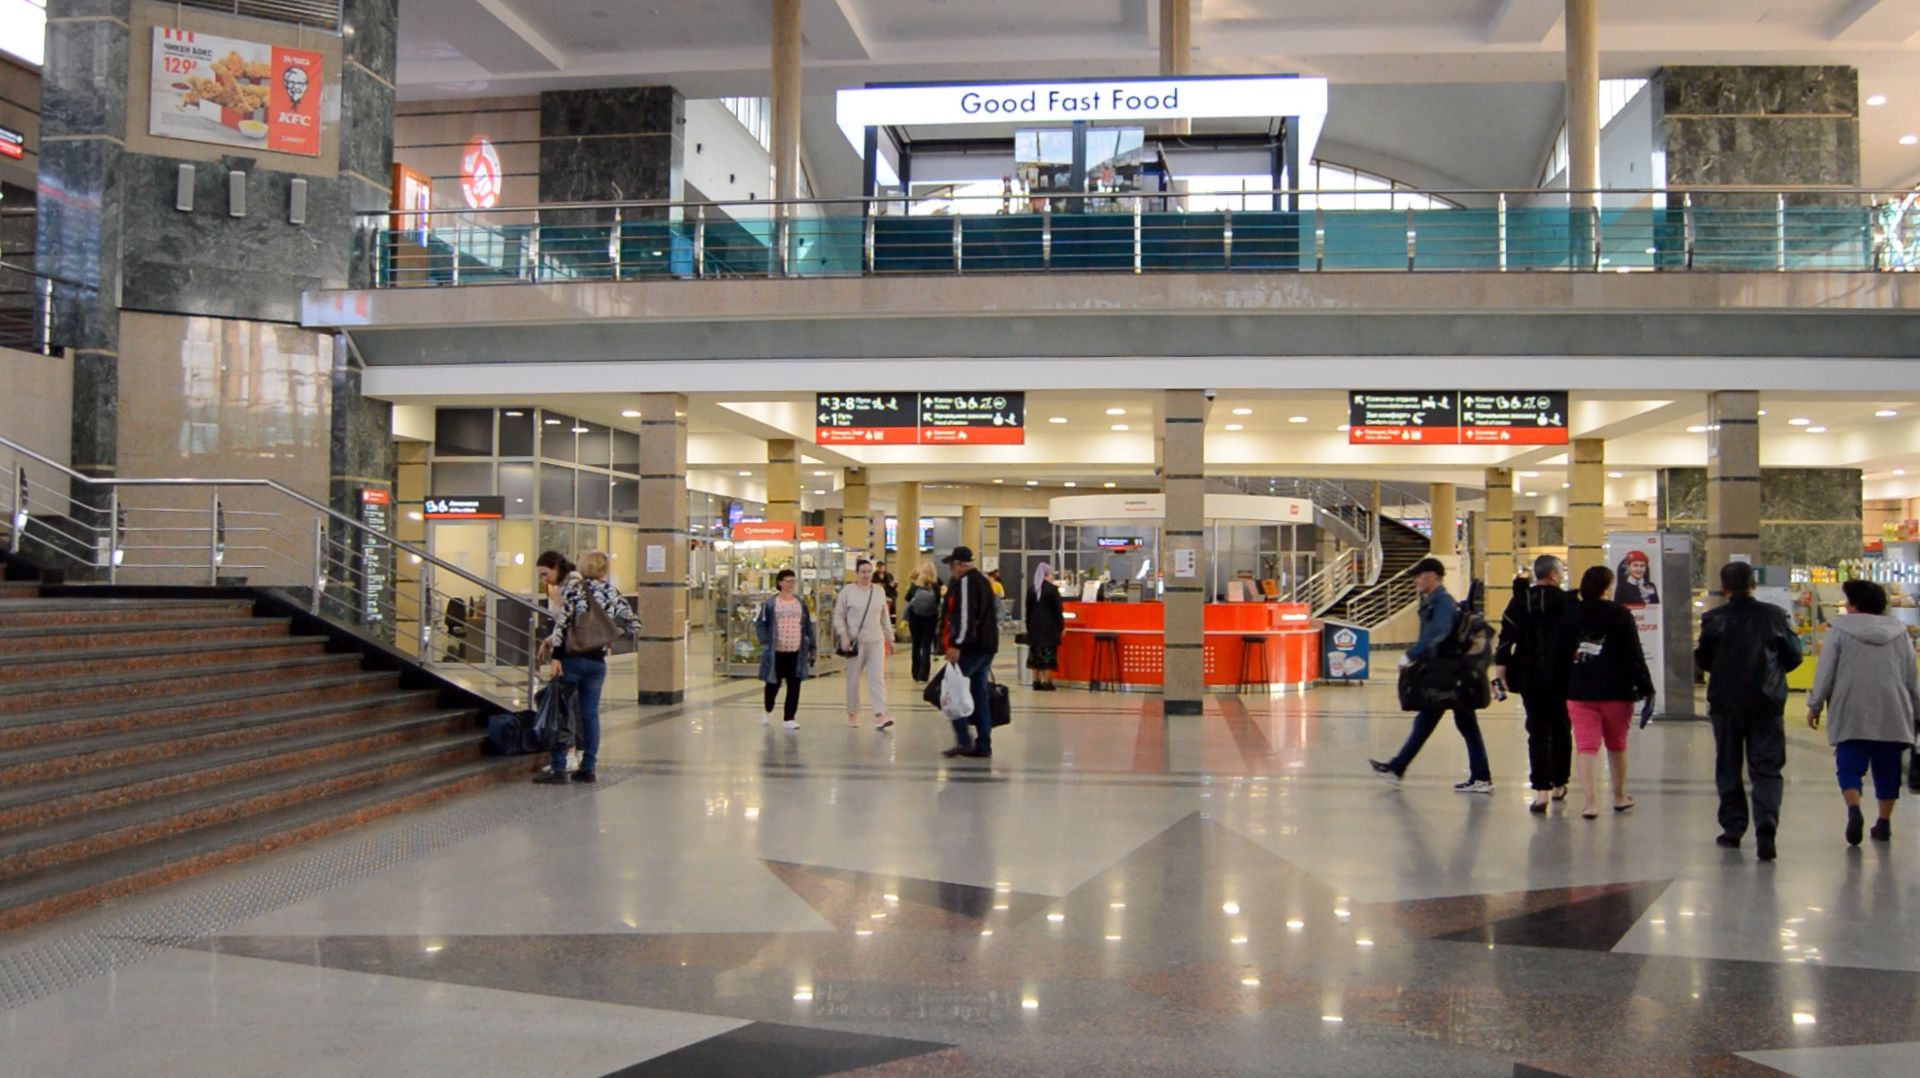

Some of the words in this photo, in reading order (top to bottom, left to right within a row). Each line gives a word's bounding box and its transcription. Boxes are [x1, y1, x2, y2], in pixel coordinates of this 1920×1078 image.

[191, 47, 213, 58] БОКС
[961, 90, 1036, 114] Good
[1048, 91, 1101, 111] Fast
[1112, 87, 1179, 110] Food
[278, 112, 312, 127] KFC
